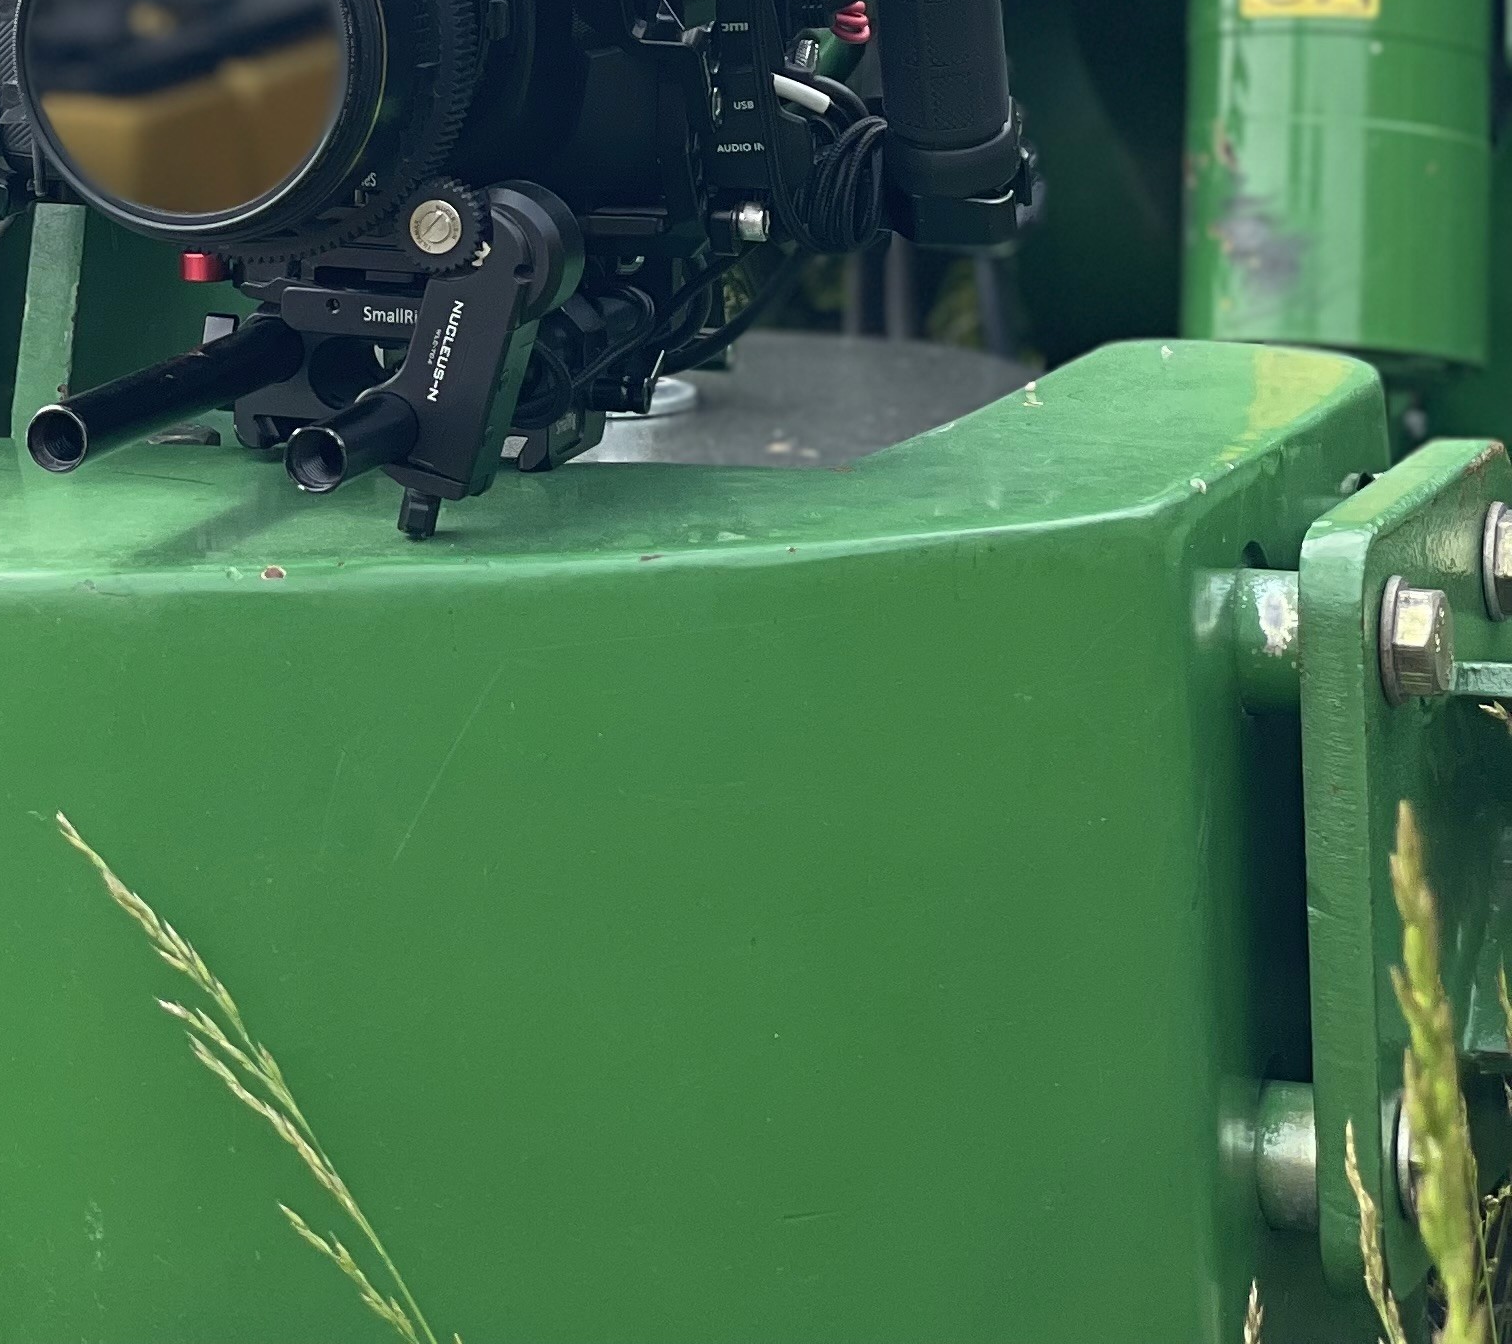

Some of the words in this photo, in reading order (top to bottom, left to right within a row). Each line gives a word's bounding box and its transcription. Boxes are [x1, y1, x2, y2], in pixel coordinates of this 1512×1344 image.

[733, 100, 754, 110] USB
[717, 143, 751, 153] AUDIO
[363, 305, 418, 324] SmallRi
[426, 299, 465, 402] NUCLEUS-N
